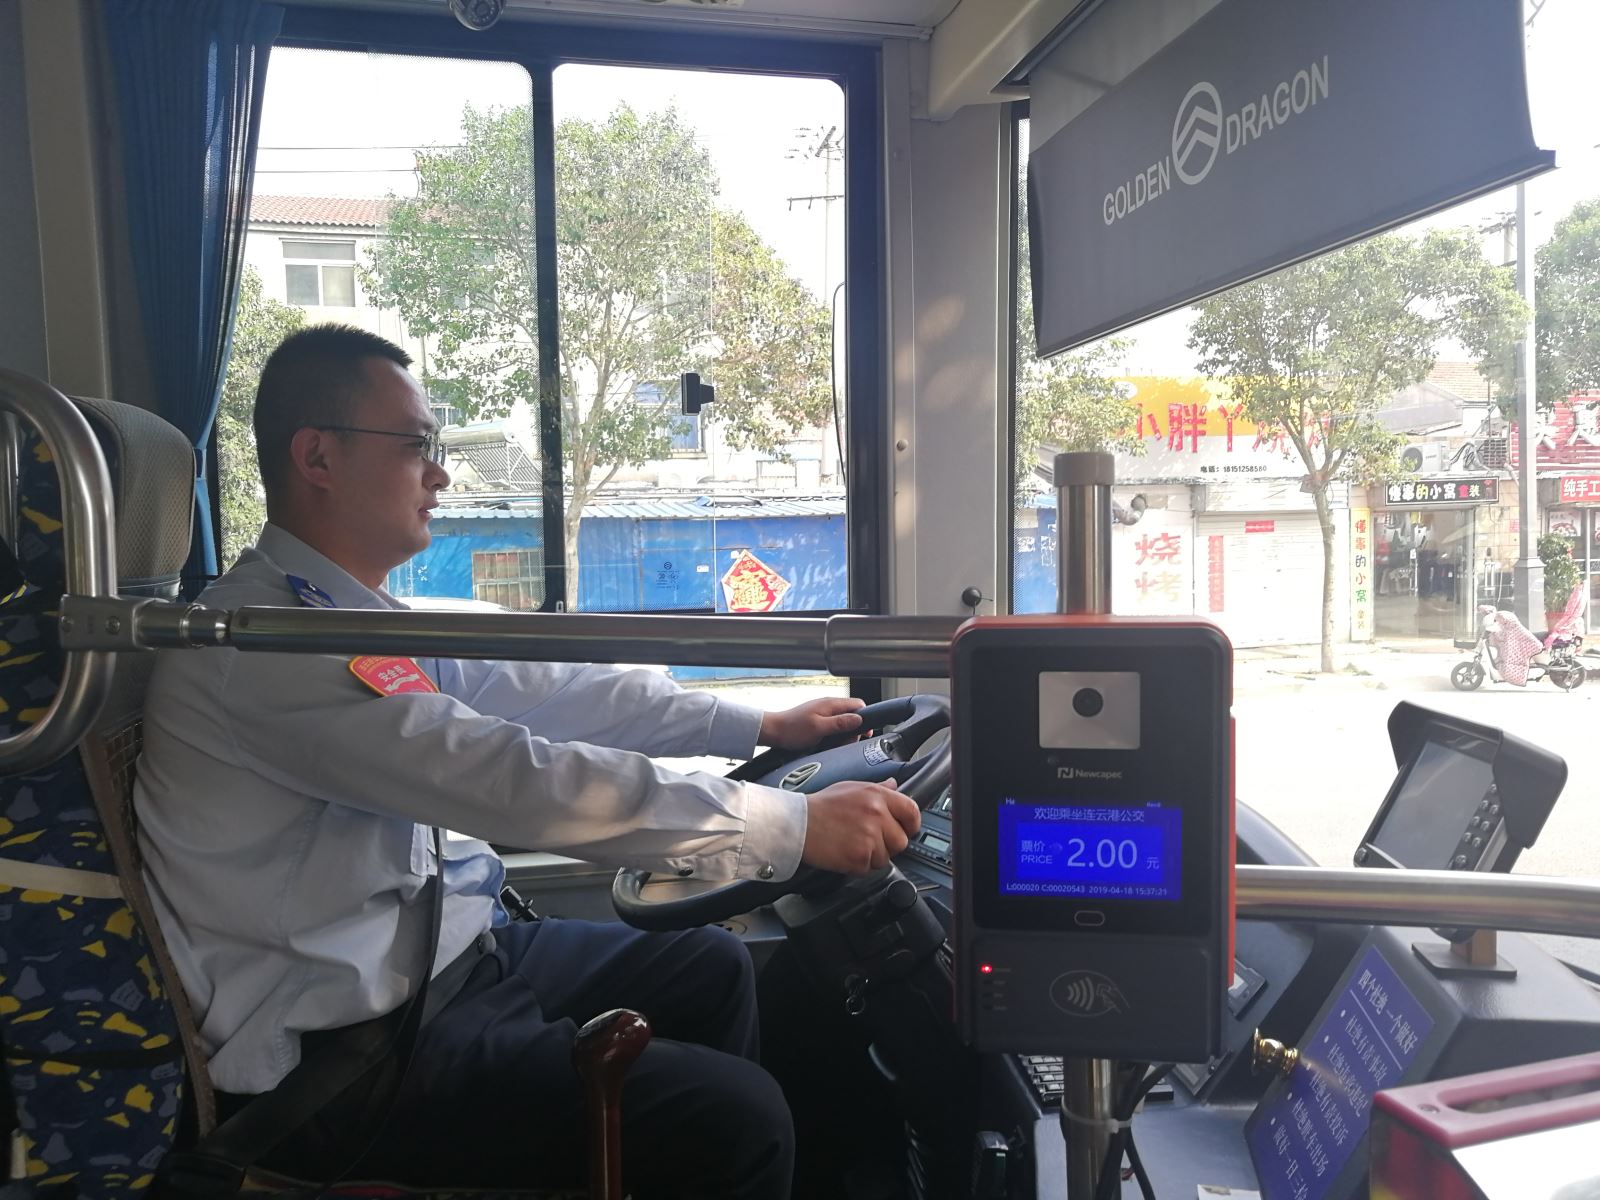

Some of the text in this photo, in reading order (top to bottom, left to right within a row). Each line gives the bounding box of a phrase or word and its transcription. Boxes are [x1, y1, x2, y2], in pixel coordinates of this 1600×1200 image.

[1102, 54, 1330, 226] GOLDEN DRAGON
[1563, 478, 1600, 498] 纯手工
[1135, 533, 1181, 602] 烧烤
[1075, 769, 1122, 779] Newcapec
[1034, 807, 1145, 822] 欢迎乘坐连云港公交
[1021, 840, 1045, 852] 票价
[1067, 838, 1138, 868] 2.00
[1021, 854, 1053, 864] PRICE
[1146, 856, 1160, 869] 元
[1358, 968, 1418, 1055] 四个杜绝 一个做好
[1345, 1015, 1388, 1086] 杜绝有责事故
[1309, 1071, 1349, 1147] 杜绝有责投诉
